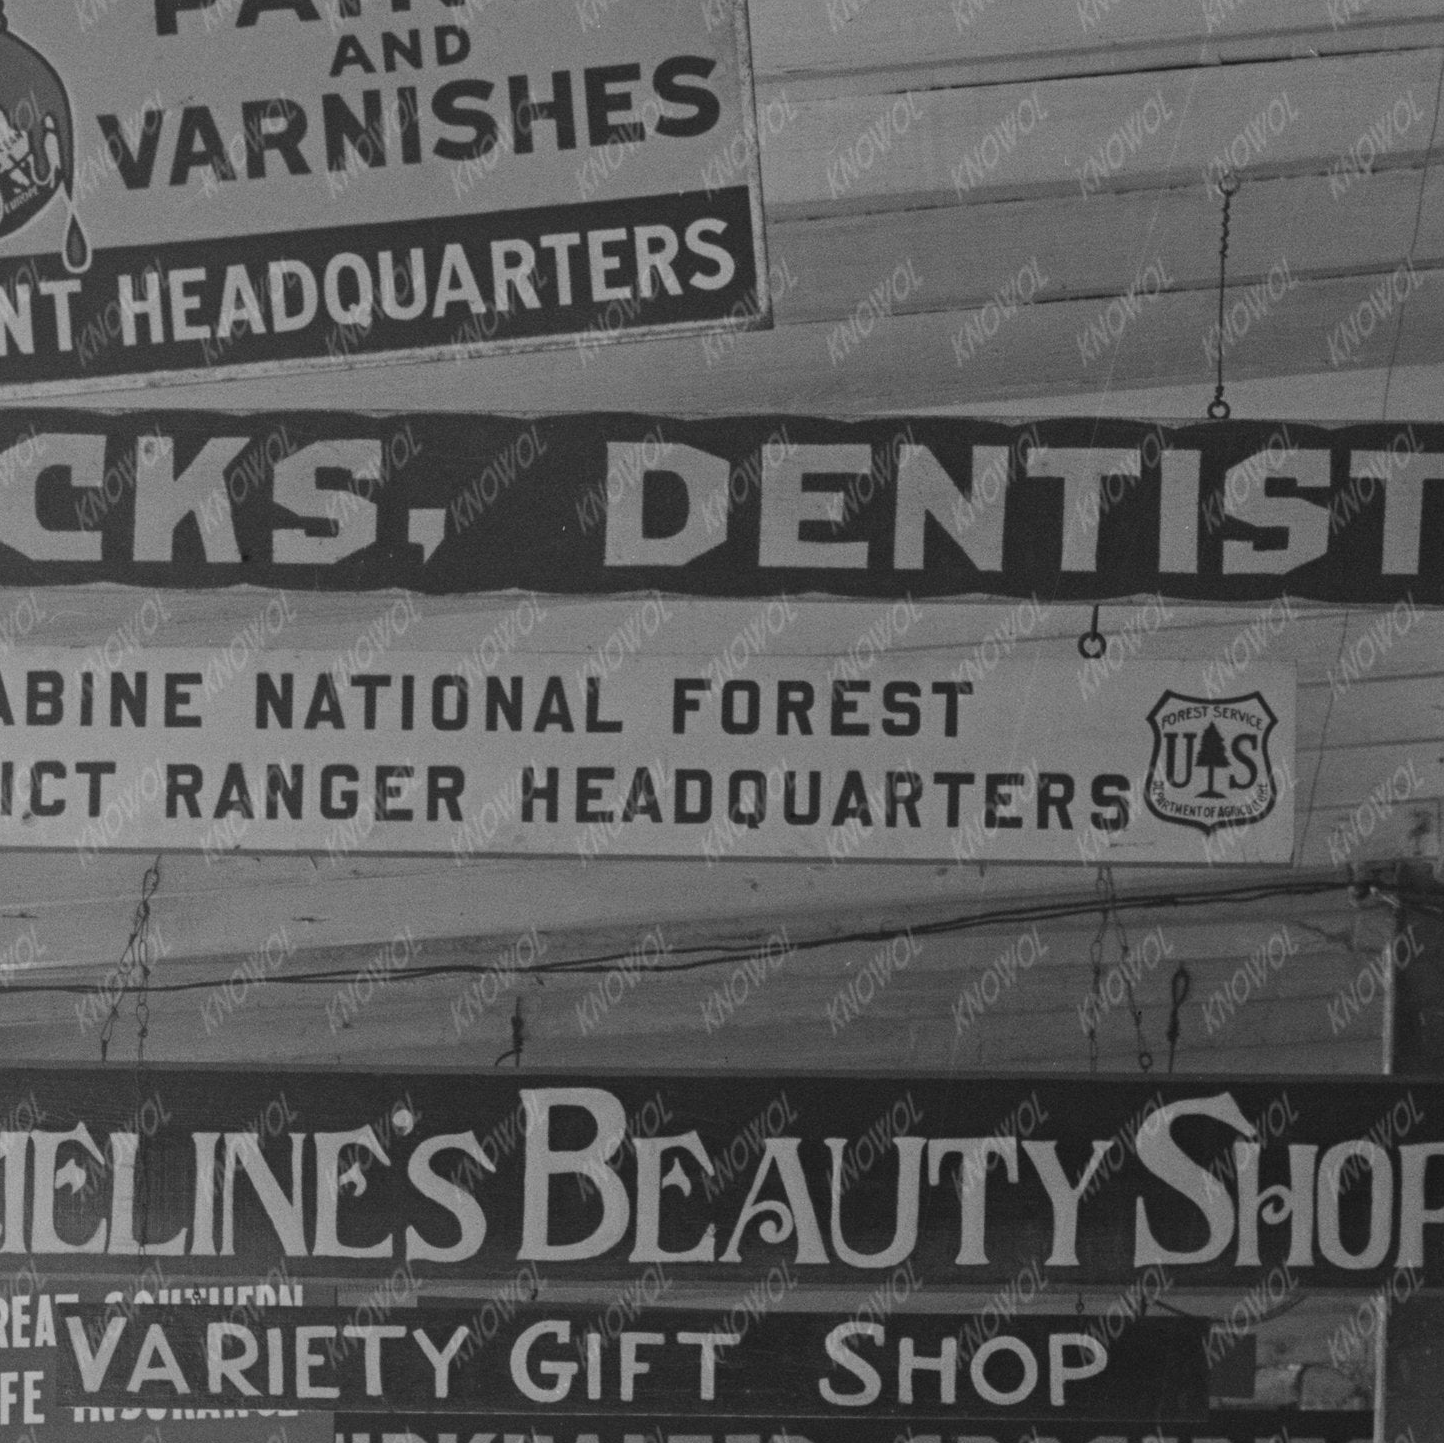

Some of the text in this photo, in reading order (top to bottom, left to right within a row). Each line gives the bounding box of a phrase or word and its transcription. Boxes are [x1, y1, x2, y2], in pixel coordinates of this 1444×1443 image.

[329, 24, 472, 77] AND
[96, 56, 723, 191] VARNISHES
[115, 218, 737, 348] HEADQUARTERS
[253, 673, 624, 738] NATIONAL
[672, 678, 974, 740] FOREST
[1161, 705, 1263, 731] FOREST SERVICE
[162, 758, 469, 828] RANGER
[517, 764, 1130, 836] HEADQUARTERS
[1203, 805, 1216, 817] OF
[517, 1087, 1116, 1269] BEAUTY
[65, 1315, 1108, 1408] VARIETY GIFT SHOP
